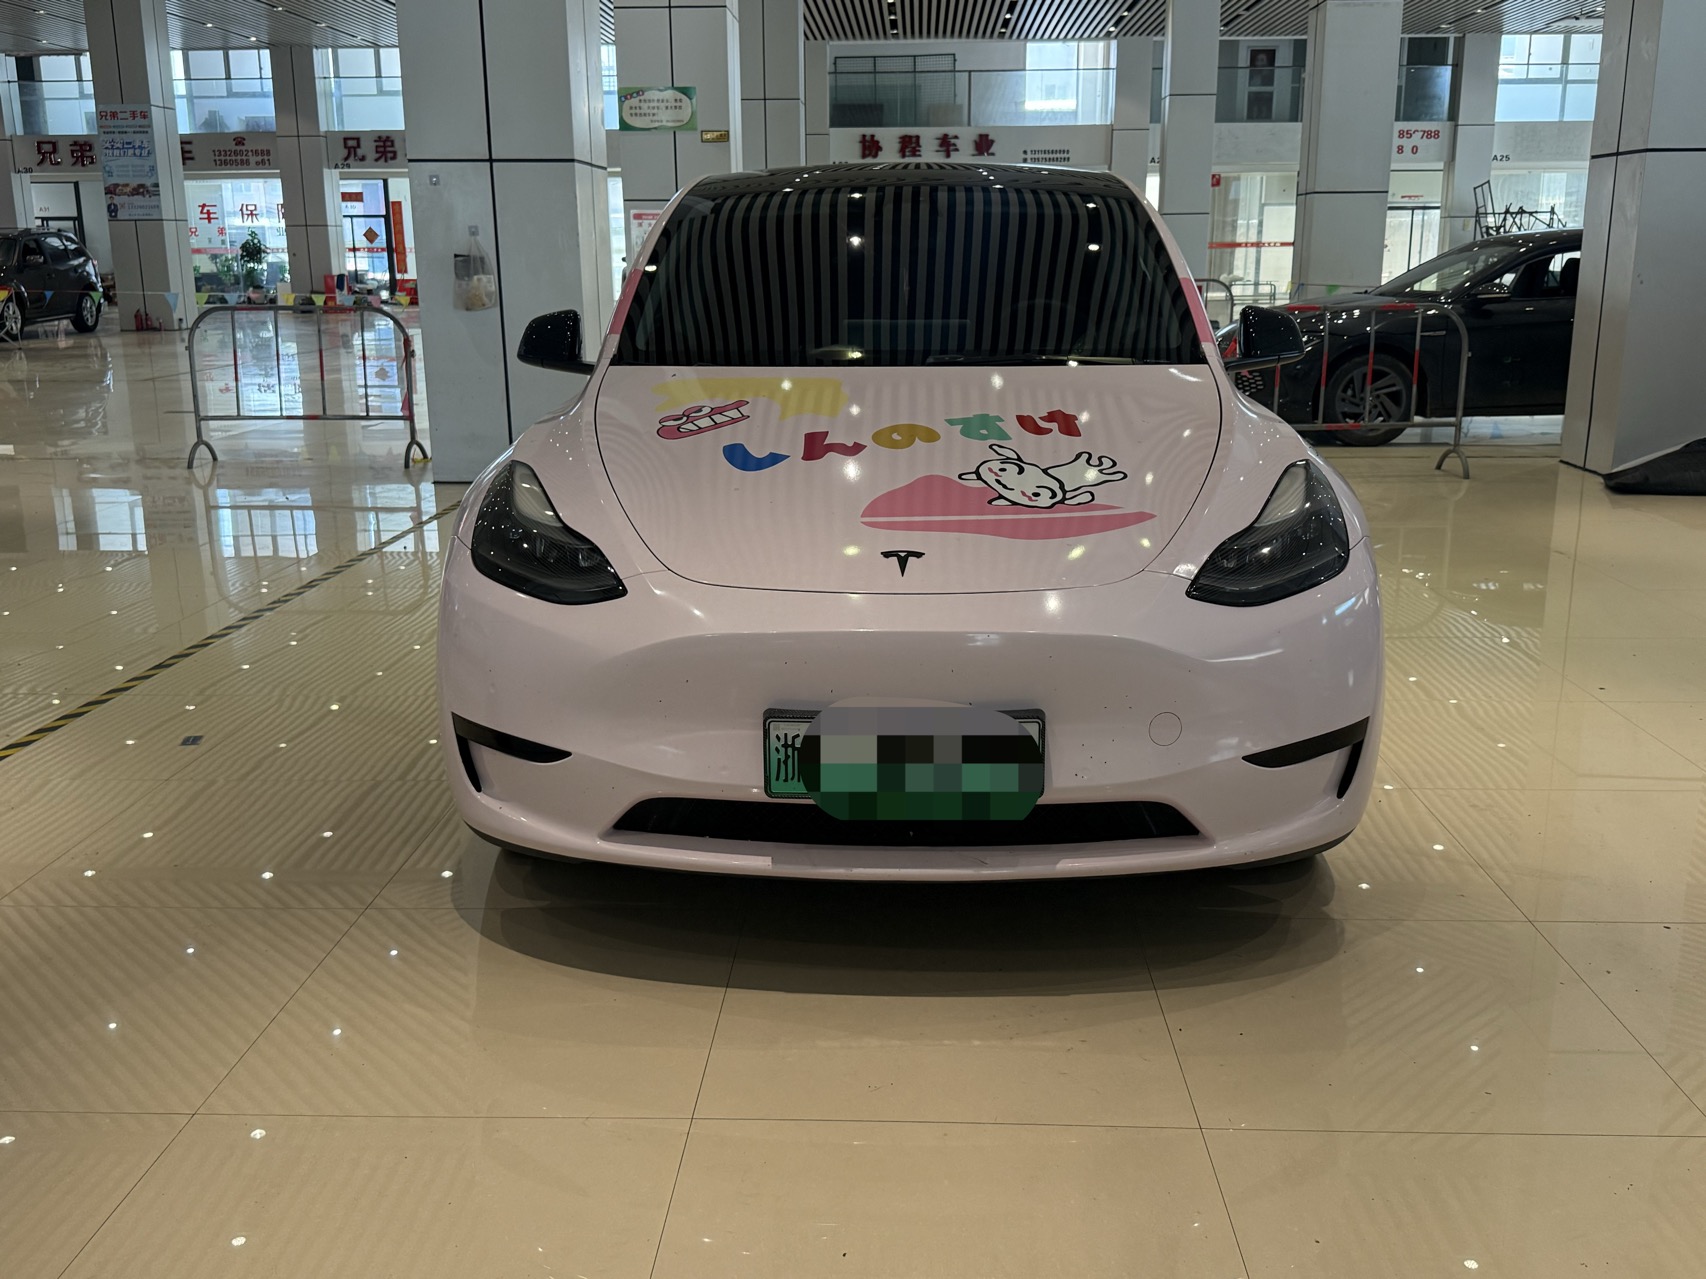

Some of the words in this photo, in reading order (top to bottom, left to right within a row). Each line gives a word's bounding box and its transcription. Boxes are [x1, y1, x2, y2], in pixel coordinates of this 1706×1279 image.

[99, 110, 149, 121] 兄弟二手车
[35, 140, 97, 167] 兄弟
[343, 135, 398, 163] 兄弟
[859, 133, 995, 159] 协程车业
[1491, 154, 1511, 162] A25
[722, 409, 1083, 472] しんのすけ
[774, 732, 802, 783] 浙
